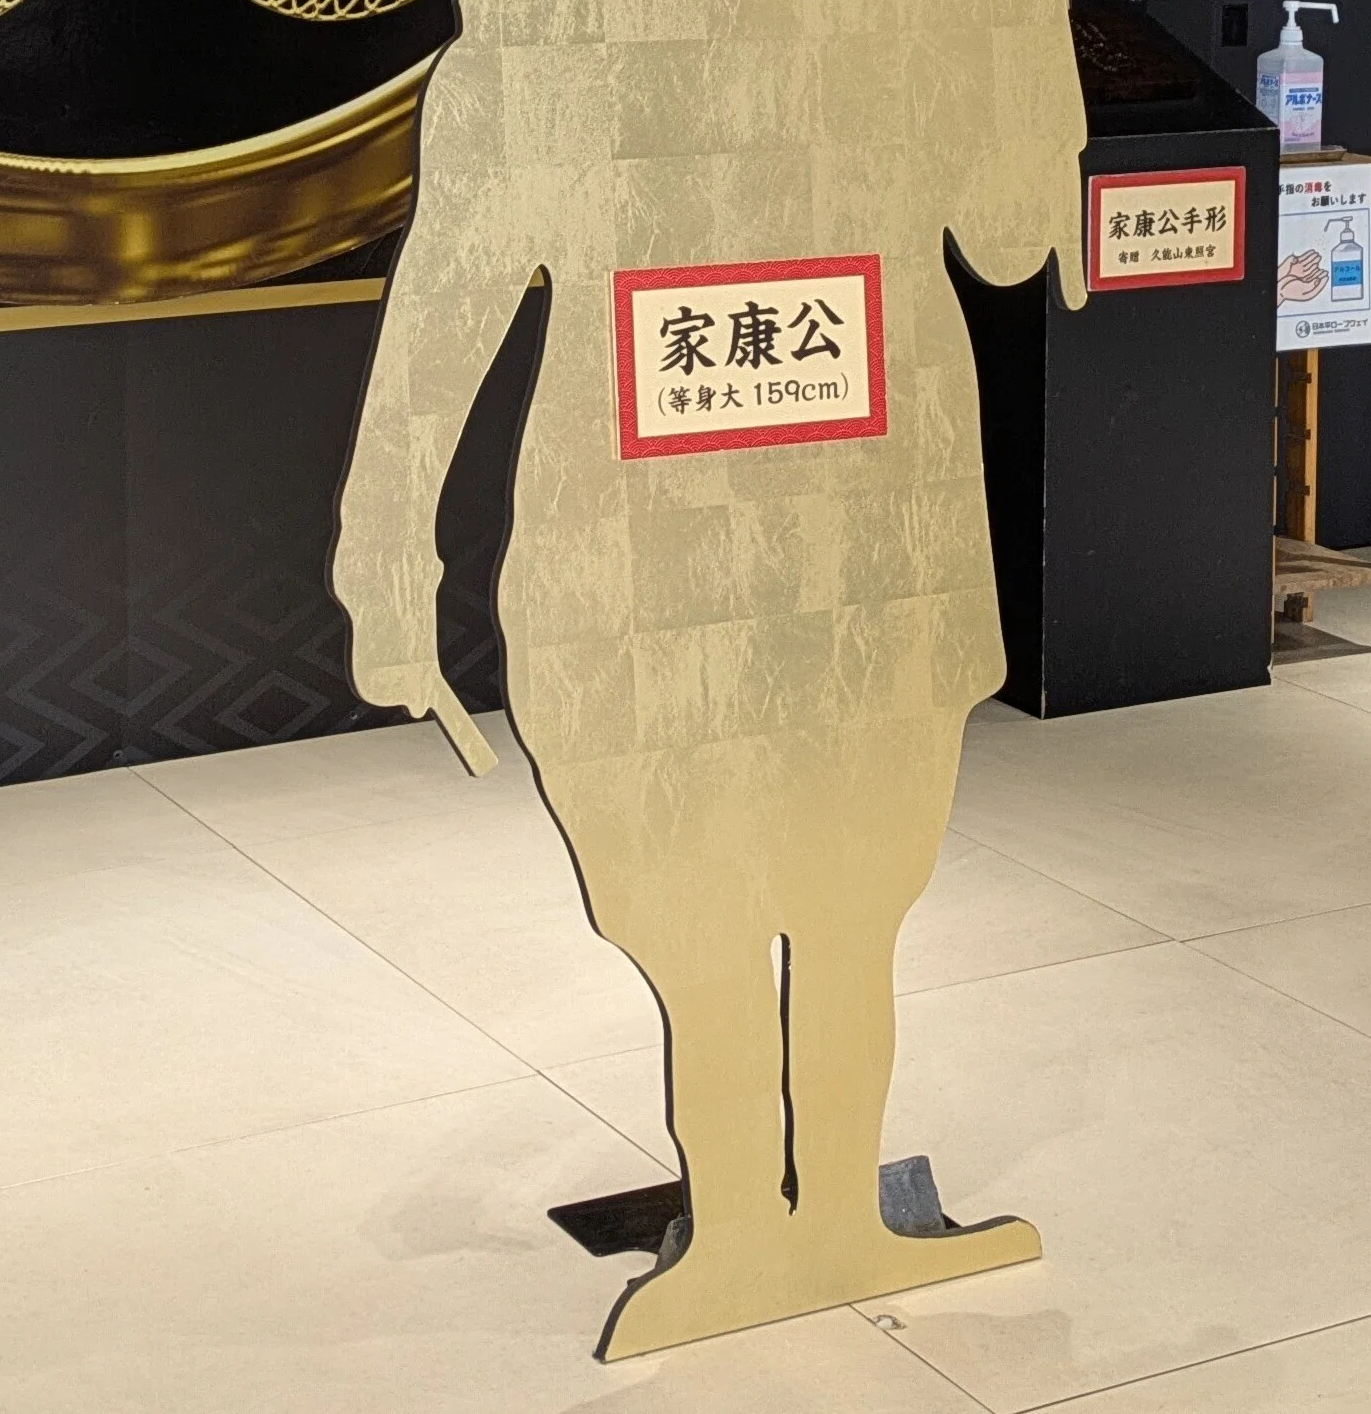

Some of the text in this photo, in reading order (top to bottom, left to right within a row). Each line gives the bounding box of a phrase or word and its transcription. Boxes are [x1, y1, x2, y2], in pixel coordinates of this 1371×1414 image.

[1311, 193, 1367, 207] お願いします
[1107, 204, 1227, 240] 家康公手形
[1117, 244, 1217, 265] 寄贈 久能山東照宮
[657, 298, 846, 377] 家康公
